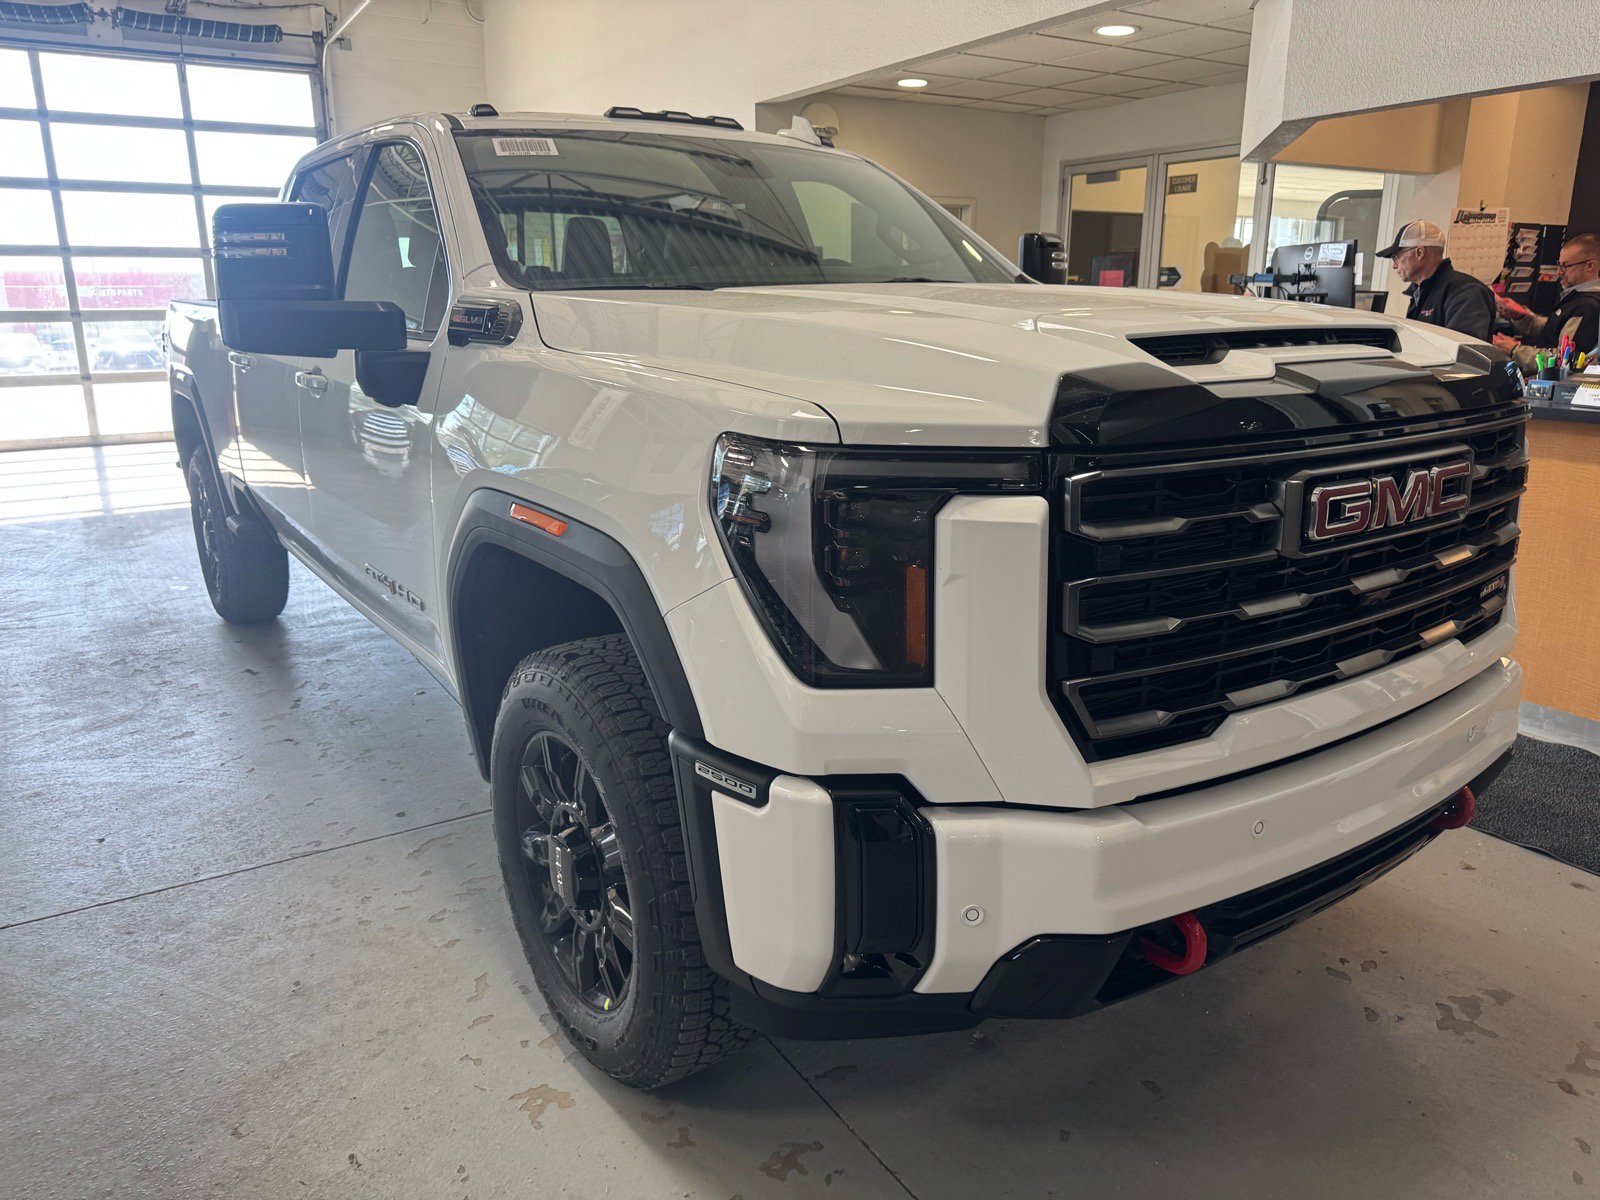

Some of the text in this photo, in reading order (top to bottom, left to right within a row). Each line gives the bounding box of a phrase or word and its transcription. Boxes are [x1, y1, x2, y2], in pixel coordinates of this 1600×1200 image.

[117, 287, 143, 297] PARTS
[1309, 460, 1471, 540] GMC
[698, 765, 753, 793] 2500
